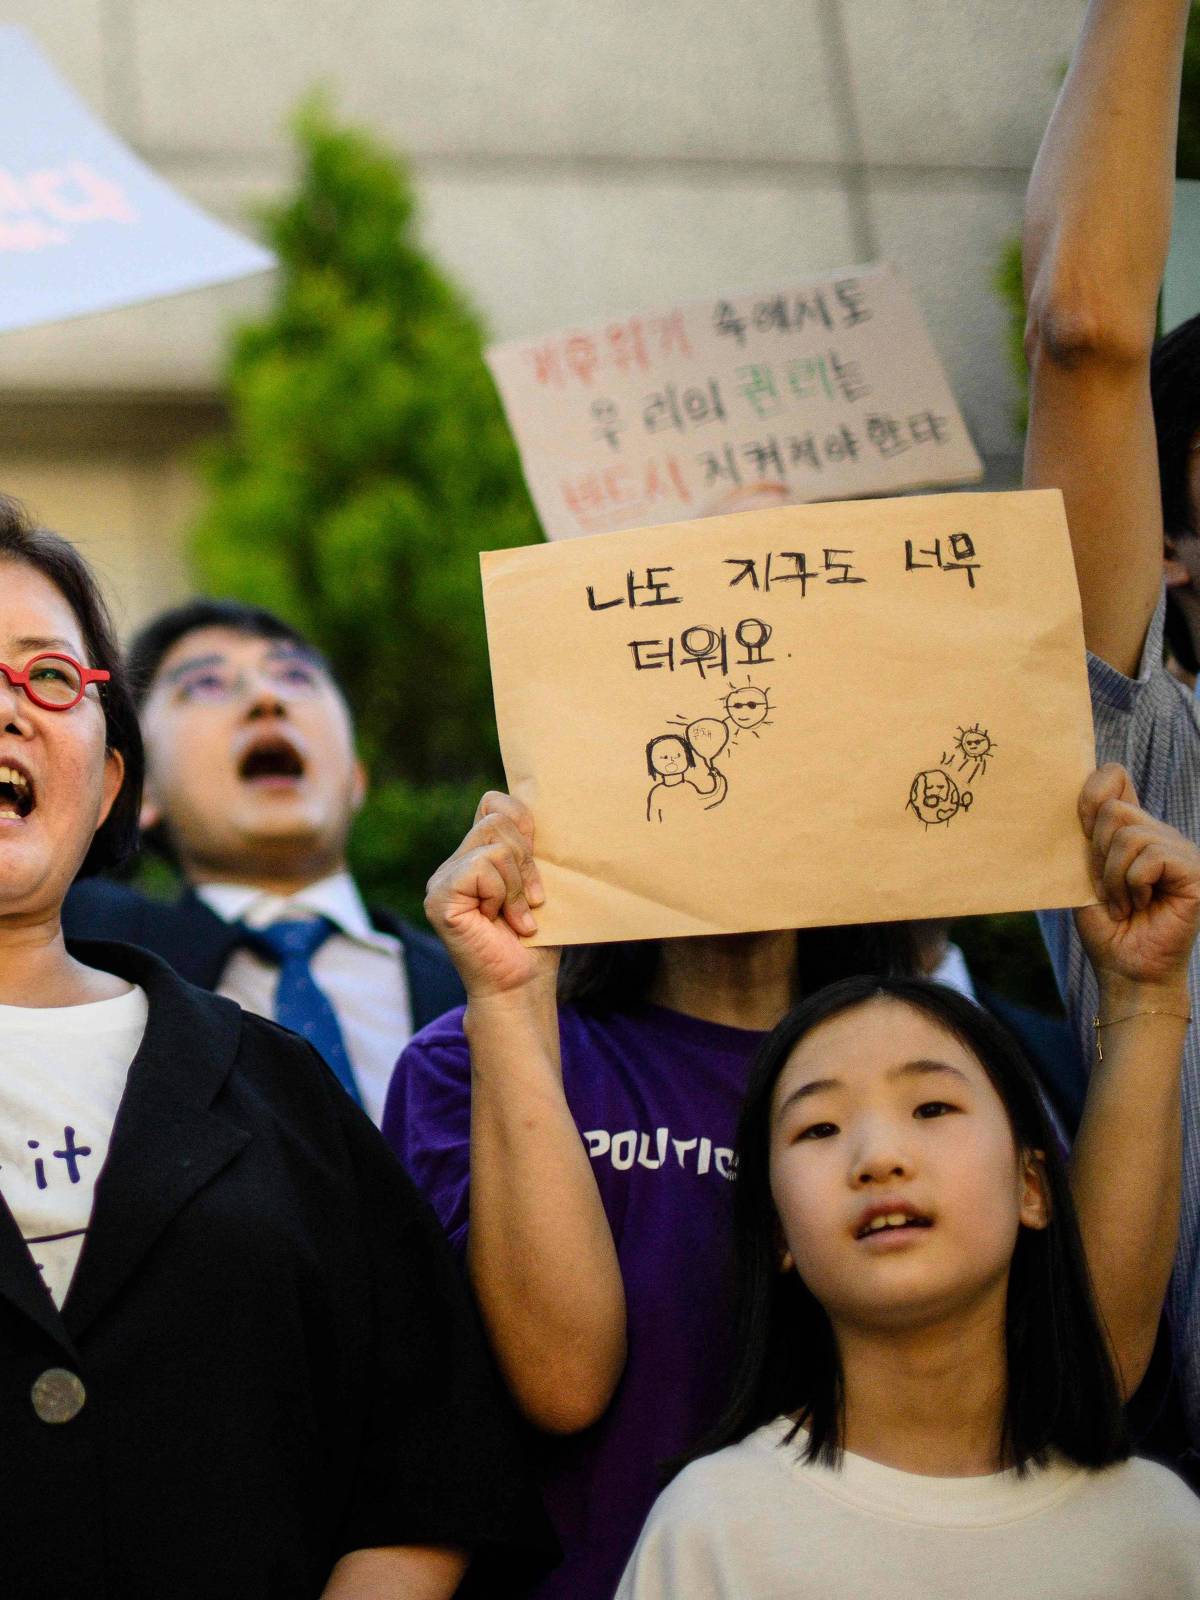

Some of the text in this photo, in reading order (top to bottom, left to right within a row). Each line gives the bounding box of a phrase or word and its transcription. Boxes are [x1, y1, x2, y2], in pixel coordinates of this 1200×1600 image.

[714, 279, 874, 345] 속에서도
[738, 349, 873, 418] 권리는
[586, 532, 982, 611] 나도 지구도 너무
[27, 1125, 92, 1190] it
